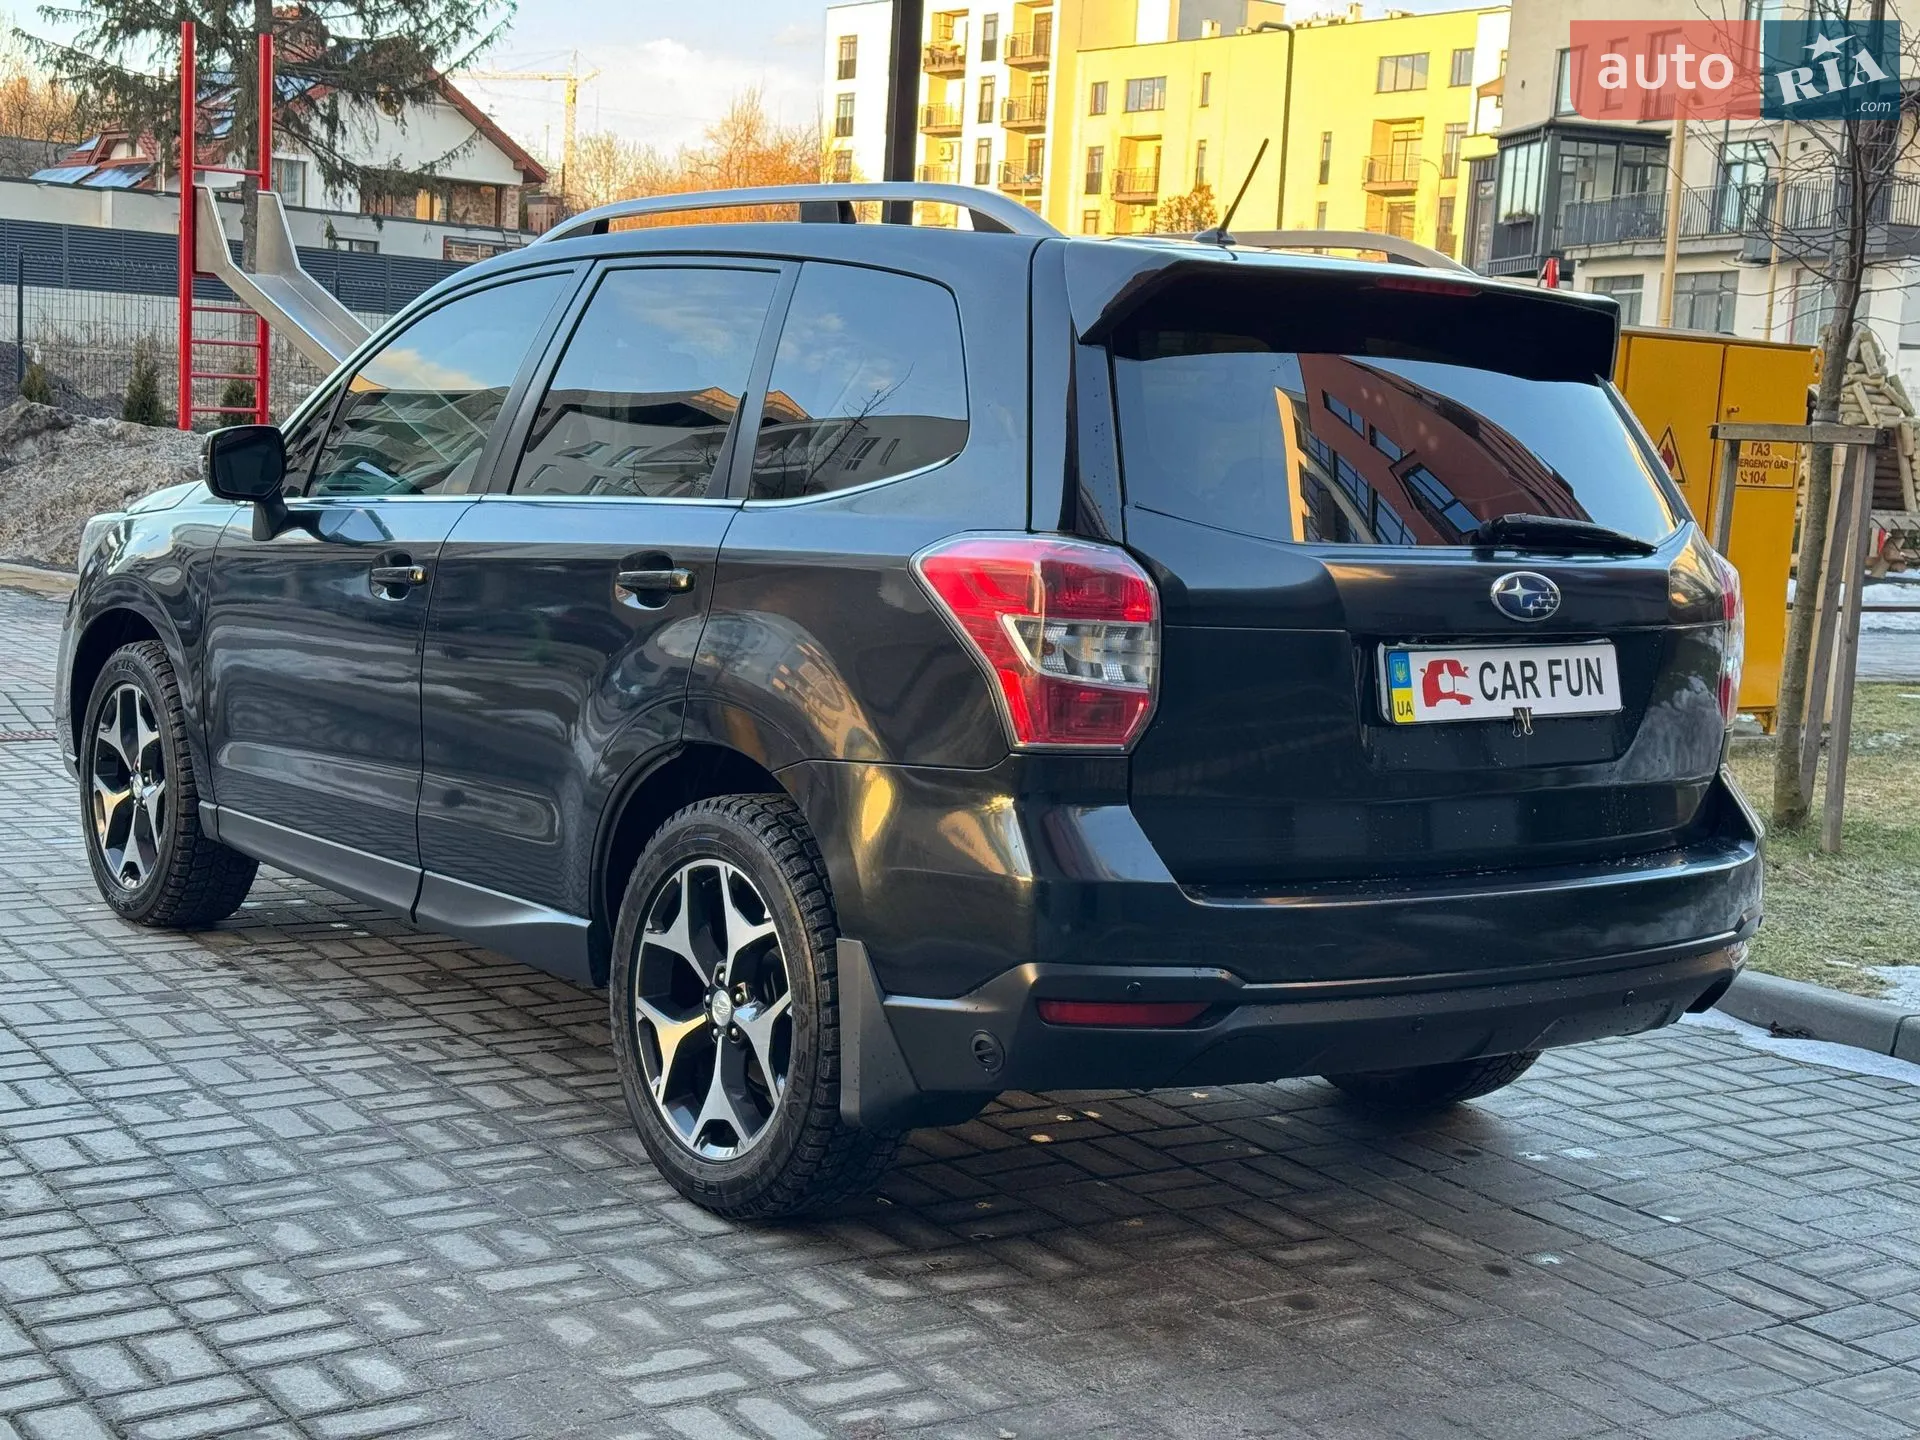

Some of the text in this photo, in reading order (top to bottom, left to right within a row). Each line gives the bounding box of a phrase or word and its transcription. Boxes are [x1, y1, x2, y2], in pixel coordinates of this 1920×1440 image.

[1751, 443, 1770, 456] ГАЗ
[1739, 459, 1788, 469] ERGENCY GAS
[1749, 471, 1766, 484] 104
[1479, 656, 1604, 701] CAR FUN
[1397, 700, 1414, 716] UA
